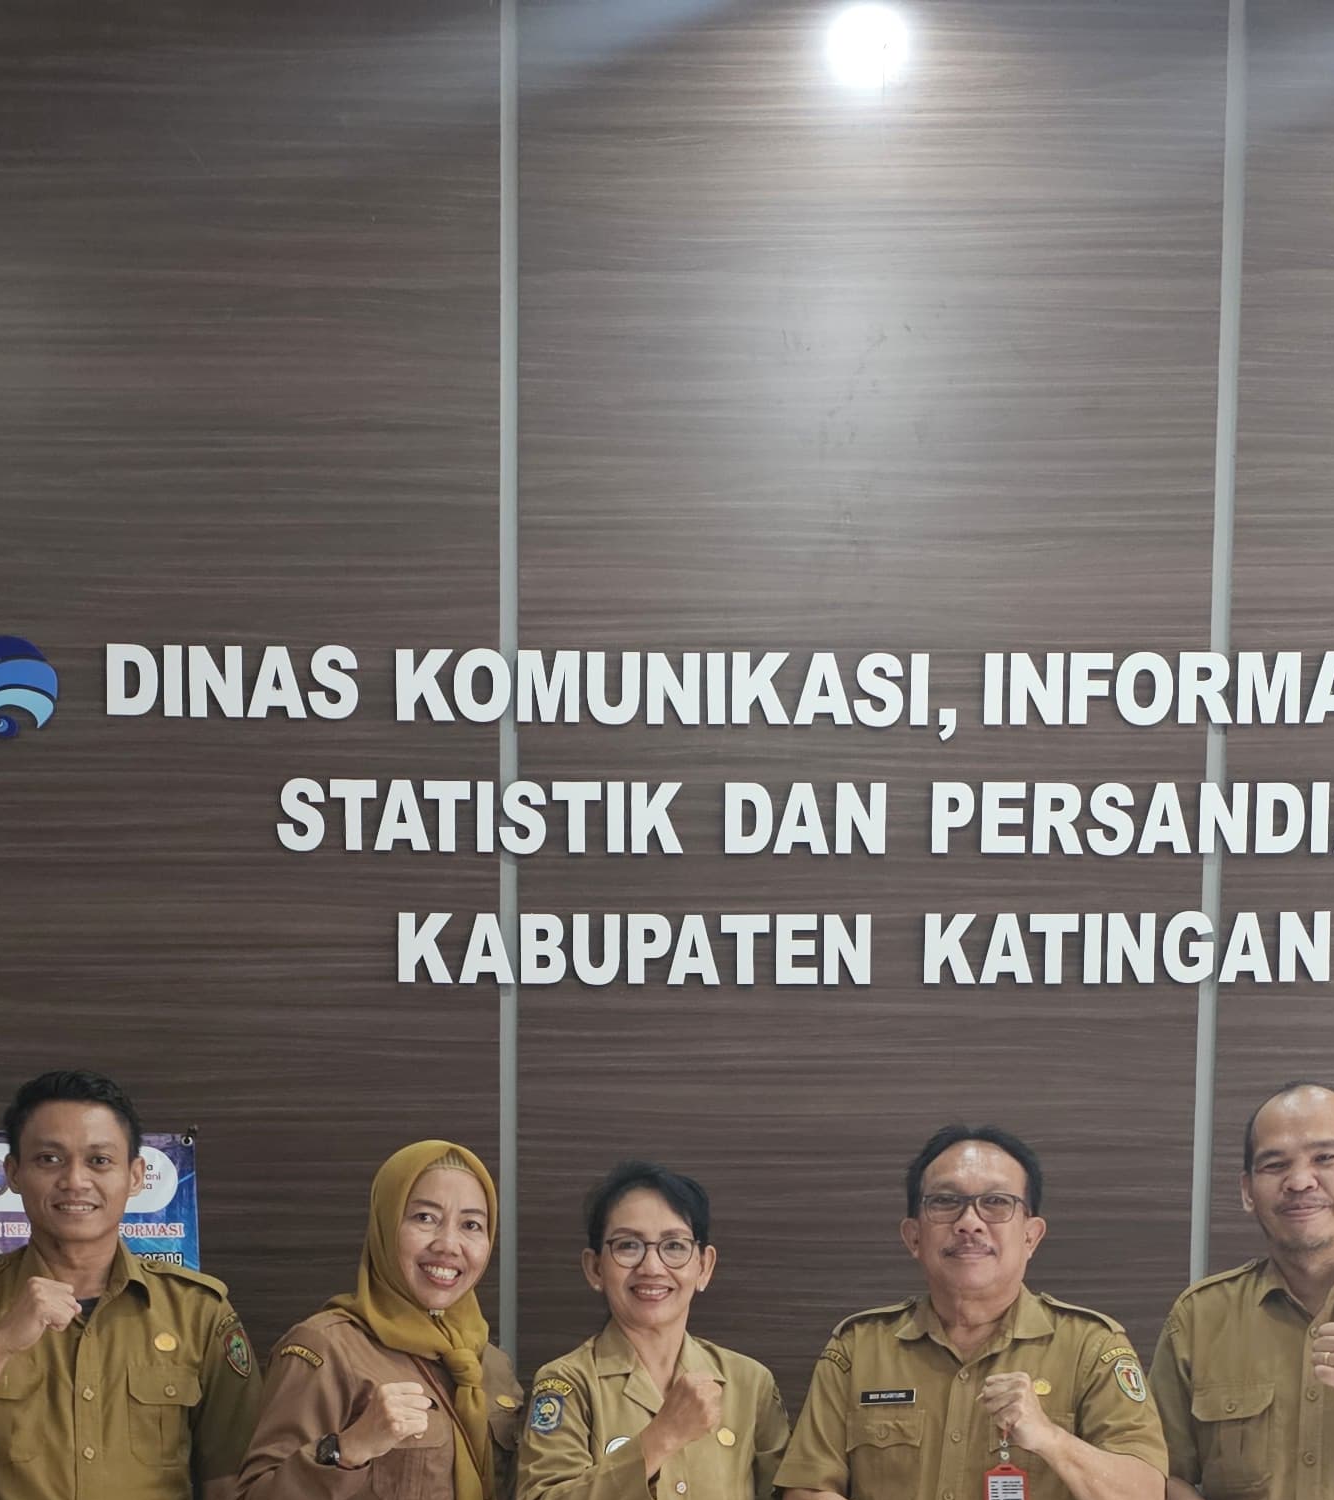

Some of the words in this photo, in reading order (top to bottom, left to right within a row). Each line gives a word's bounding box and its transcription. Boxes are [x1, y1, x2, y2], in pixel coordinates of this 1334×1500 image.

[106, 644, 359, 719] DINAS
[395, 648, 957, 740] KOMUNIKASI,
[277, 778, 682, 855] STATISTIK
[724, 782, 887, 854] DAN
[398, 912, 872, 986] KABUPATEN
[923, 910, 1331, 985] KATINGAN
[118, 1222, 186, 1239] FORMASI
